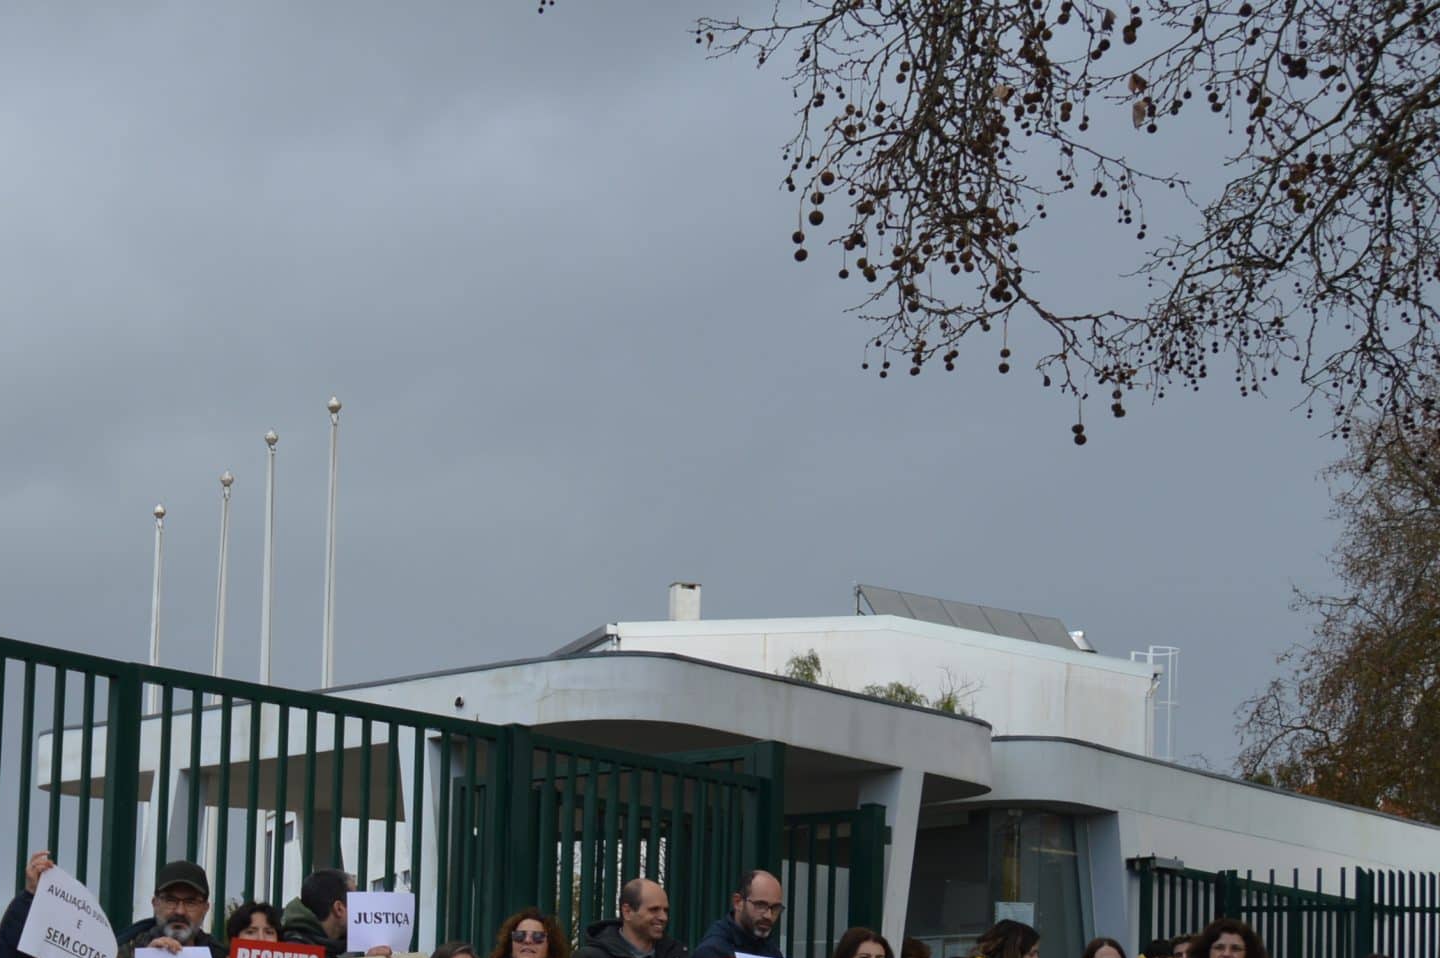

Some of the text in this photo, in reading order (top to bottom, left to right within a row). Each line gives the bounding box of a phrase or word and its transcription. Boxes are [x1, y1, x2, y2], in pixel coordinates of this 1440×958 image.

[48, 884, 91, 915] AVALIAÇÃO
[76, 919, 83, 930] E
[354, 911, 410, 928] JUSTIÇA
[46, 927, 70, 949] SEM
